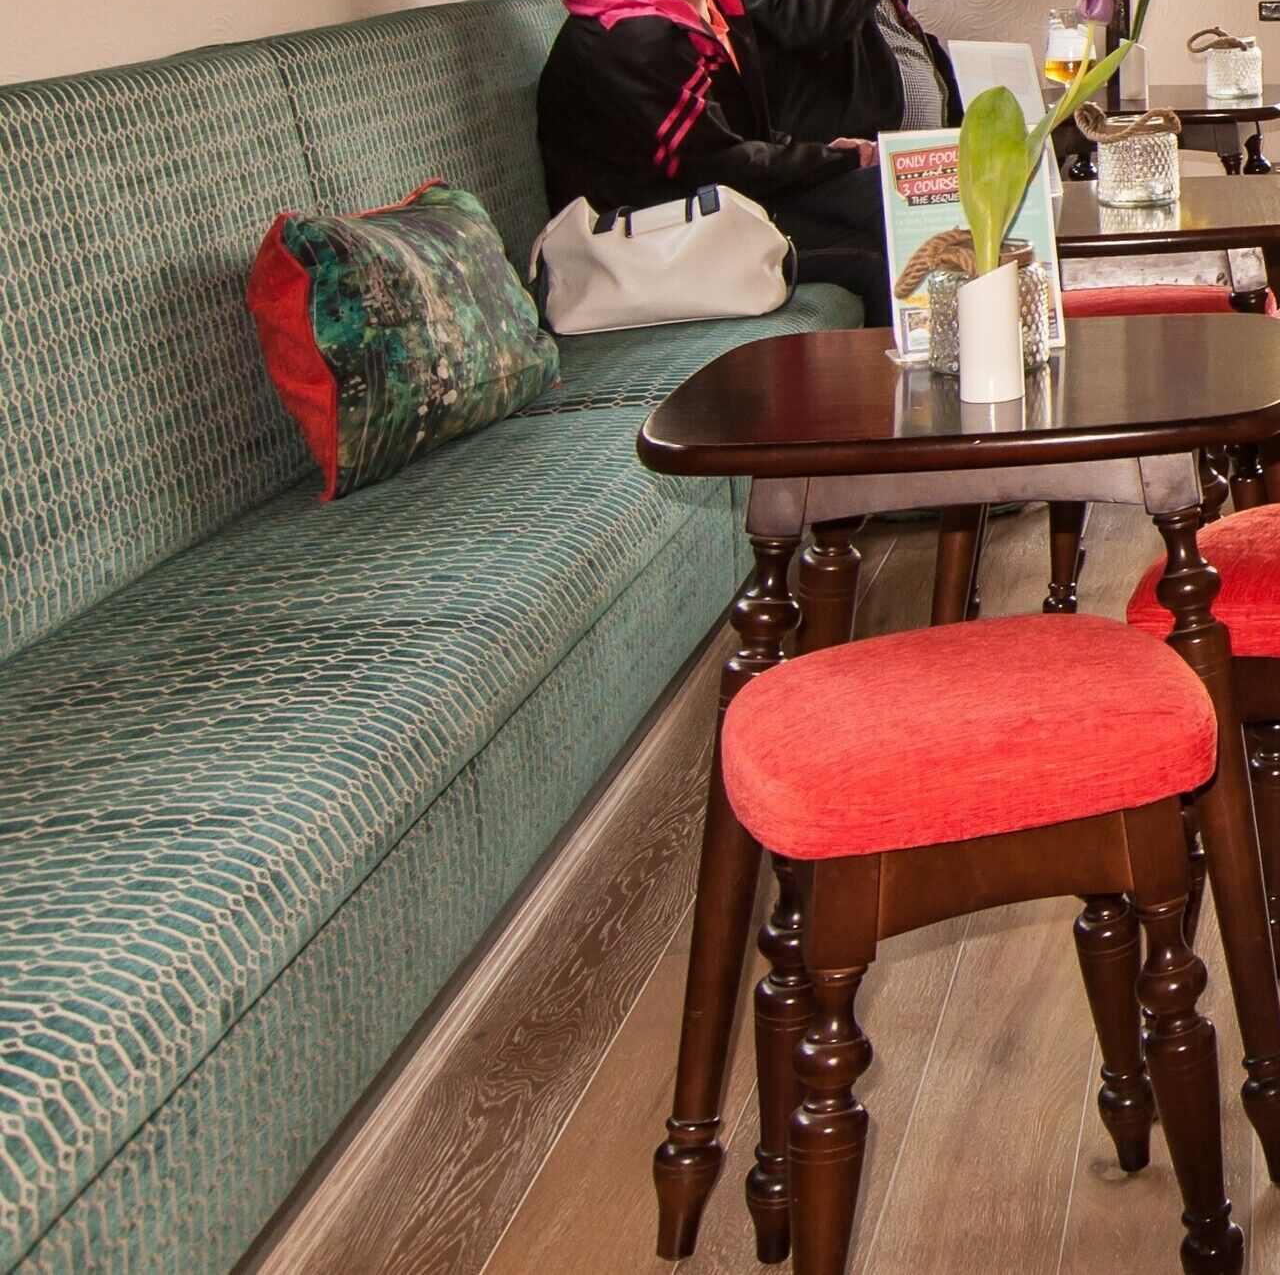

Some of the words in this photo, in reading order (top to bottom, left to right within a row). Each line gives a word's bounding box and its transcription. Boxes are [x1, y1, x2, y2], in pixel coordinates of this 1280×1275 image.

[896, 154, 926, 170] ONLY
[929, 150, 959, 166] FOOL
[921, 164, 944, 179] and
[902, 183, 912, 196] 3
[913, 176, 959, 195] COURSE
[911, 194, 929, 205] THE
[930, 192, 960, 204] SEQUE
